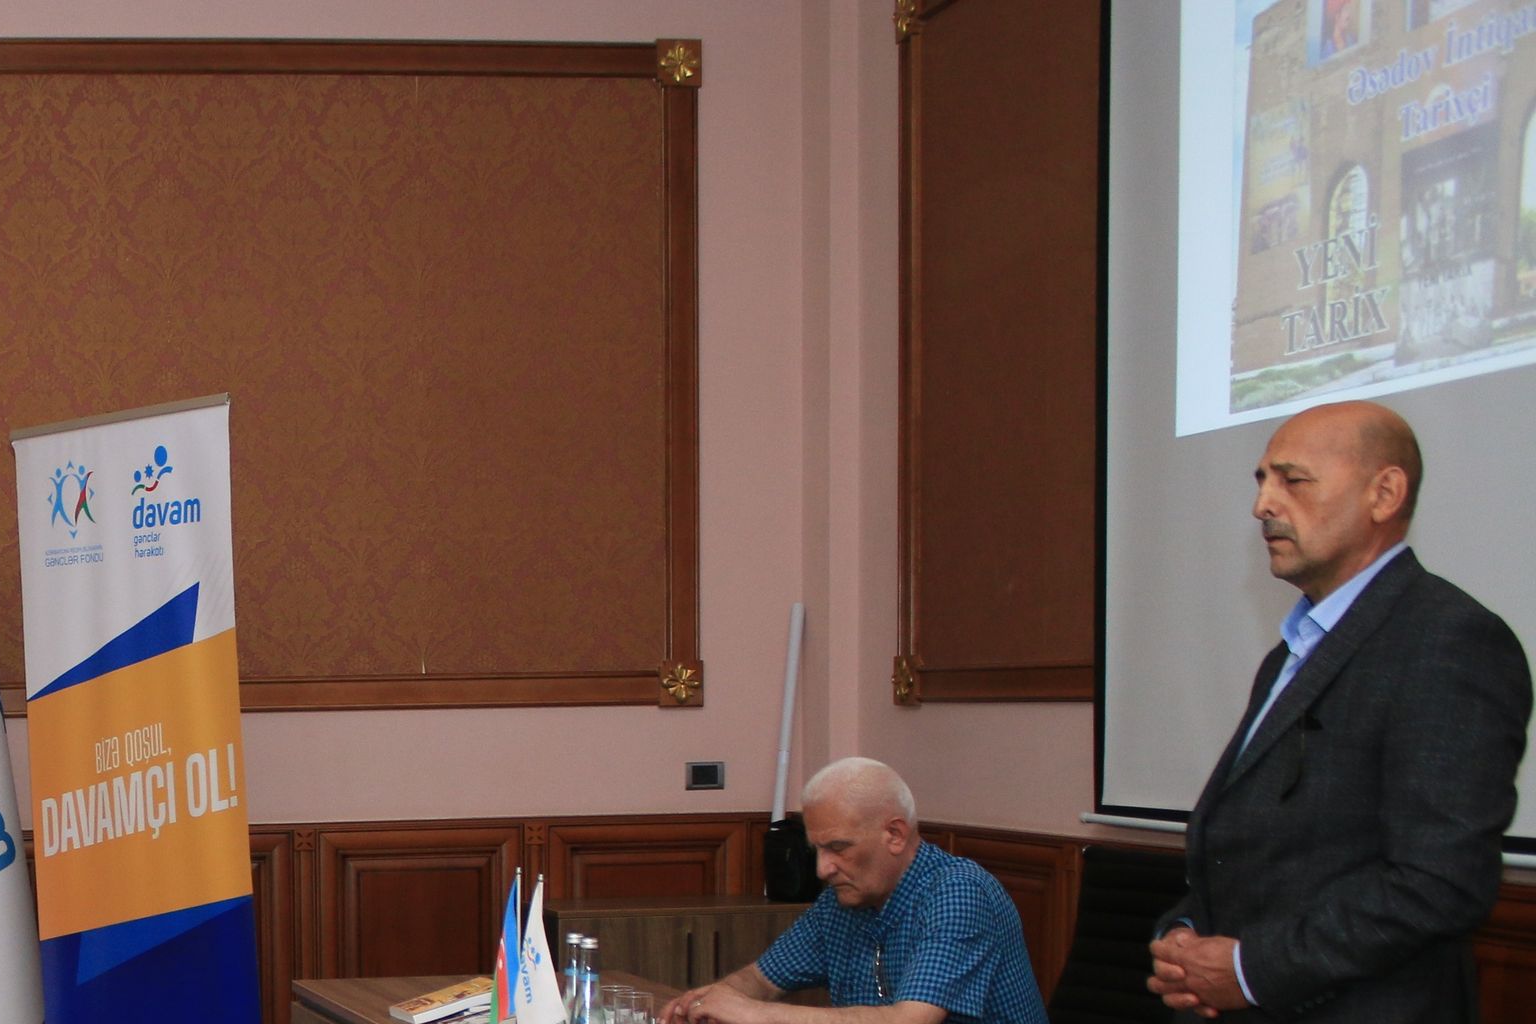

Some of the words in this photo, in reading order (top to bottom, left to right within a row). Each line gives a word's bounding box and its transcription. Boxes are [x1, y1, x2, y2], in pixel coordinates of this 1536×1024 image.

[1294, 213, 1380, 289] YENİ
[1282, 286, 1389, 355] TARİX
[132, 497, 201, 529] davam
[125, 722, 172, 767] QOŞUL,
[41, 761, 177, 858] DAVAMÇI
[186, 743, 239, 818] OL!
